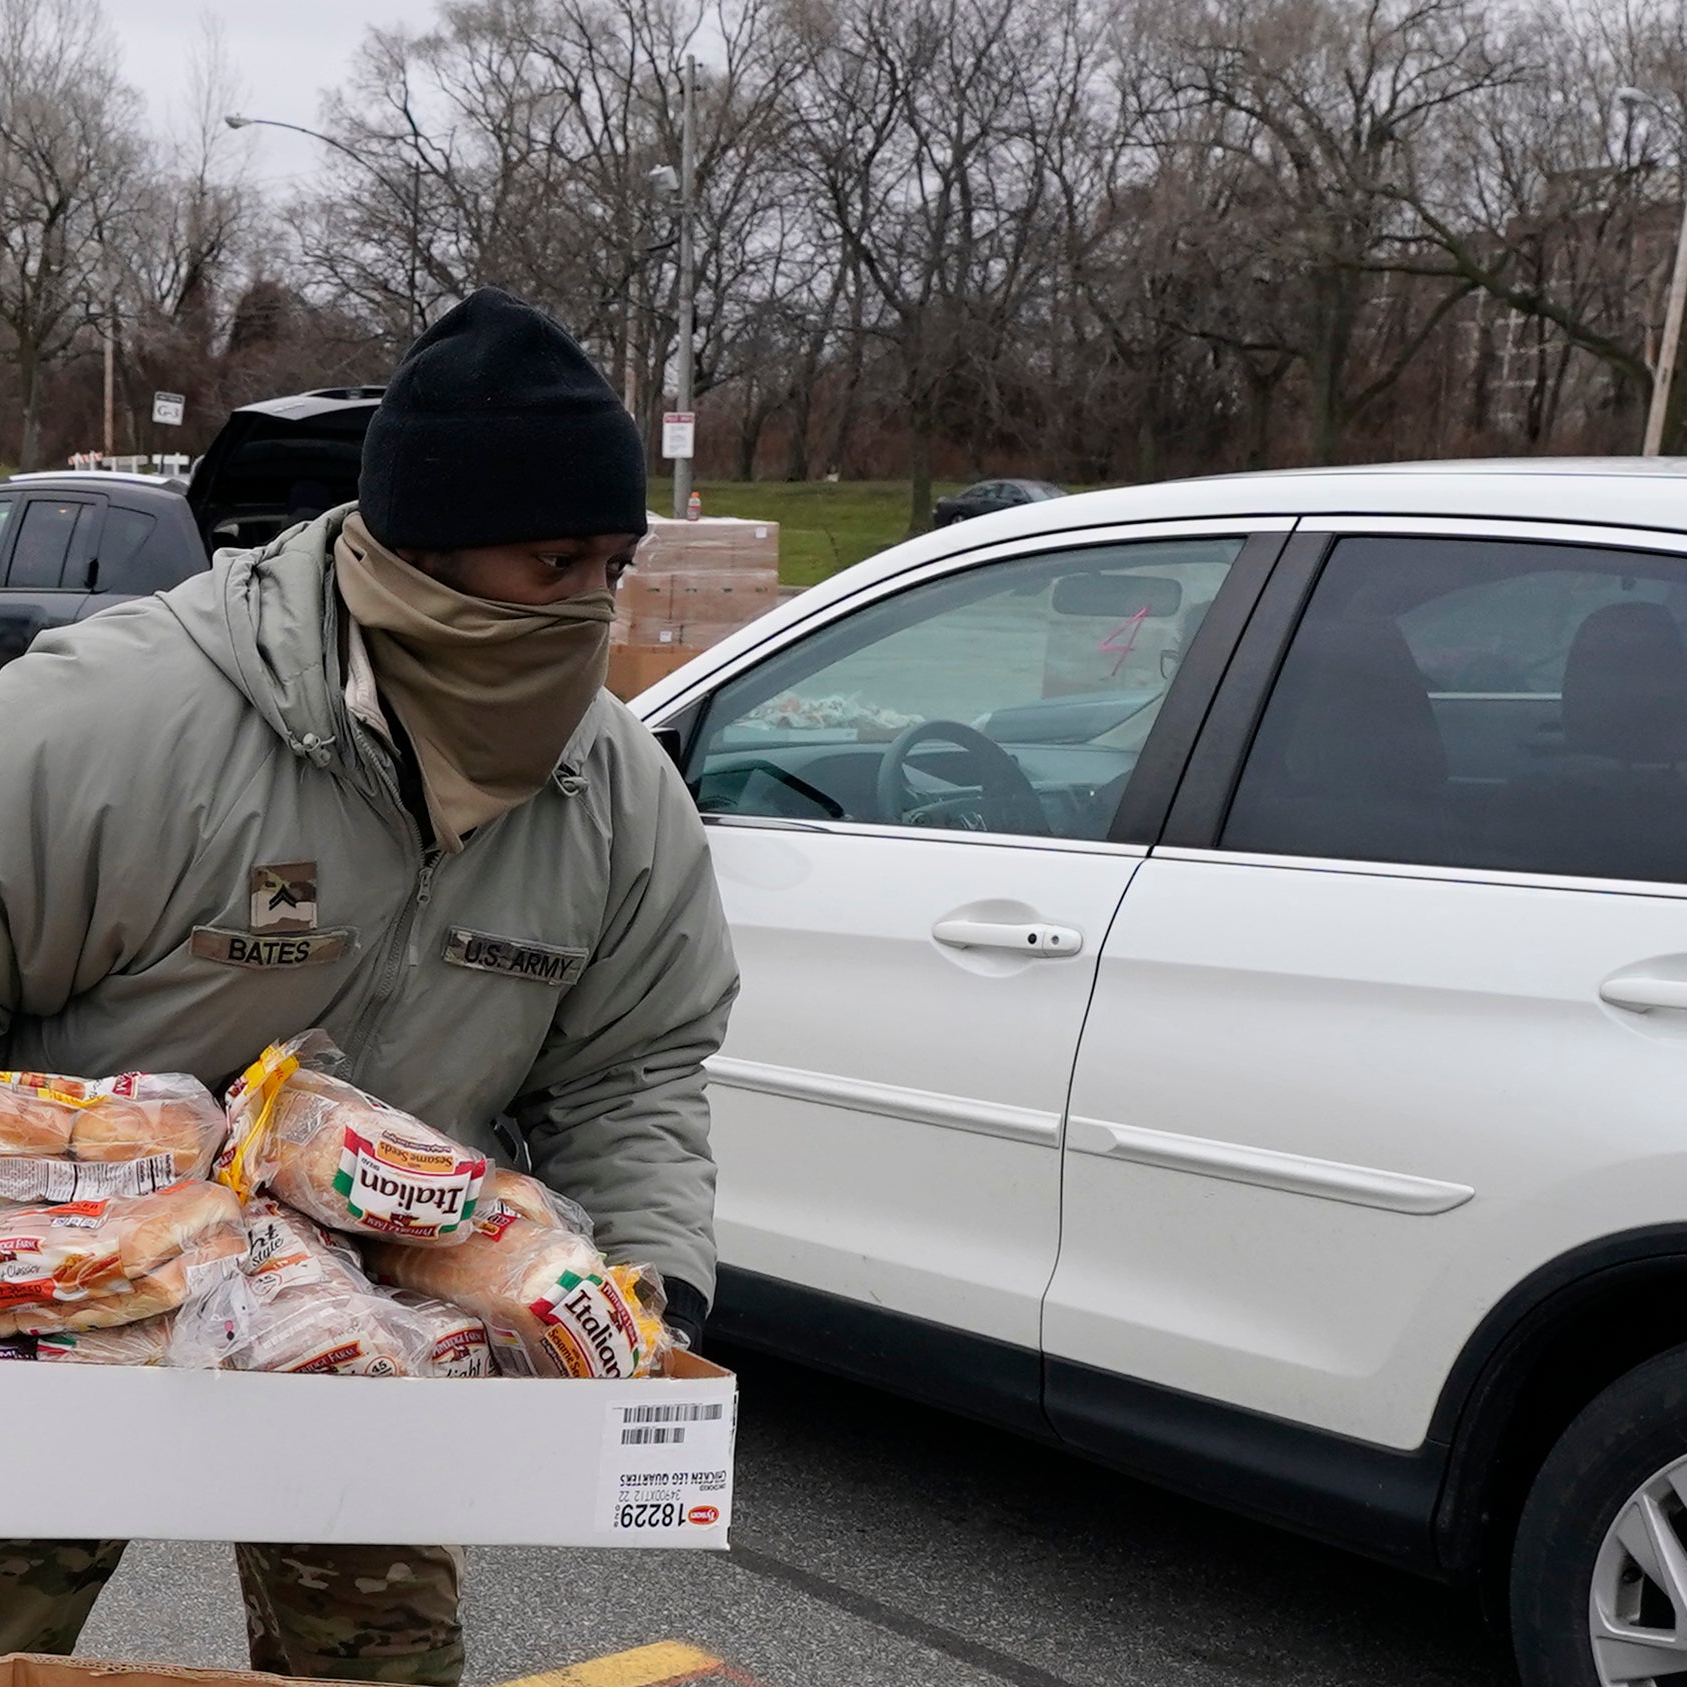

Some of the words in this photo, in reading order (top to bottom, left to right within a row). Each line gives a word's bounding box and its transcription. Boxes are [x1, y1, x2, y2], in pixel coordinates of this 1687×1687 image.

[1100, 606, 1150, 677] 4
[228, 938, 310, 965] BATES
[464, 945, 500, 967] U.S.
[511, 953, 576, 979] ARMY
[380, 1141, 408, 1160] Seeds
[410, 1152, 453, 1168] Sesame
[361, 1167, 464, 1215] Italian
[14, 1238, 40, 1252] FARM
[565, 1288, 622, 1379] Italian
[548, 1329, 576, 1365] Sesame
[620, 1472, 669, 1486] QUARTERS
[672, 1473, 688, 1485] LEG
[691, 1470, 727, 1484] CHICKEN
[618, 1490, 630, 1502] 22
[621, 1503, 686, 1528] 18229
[690, 1508, 715, 1521] Tyson
